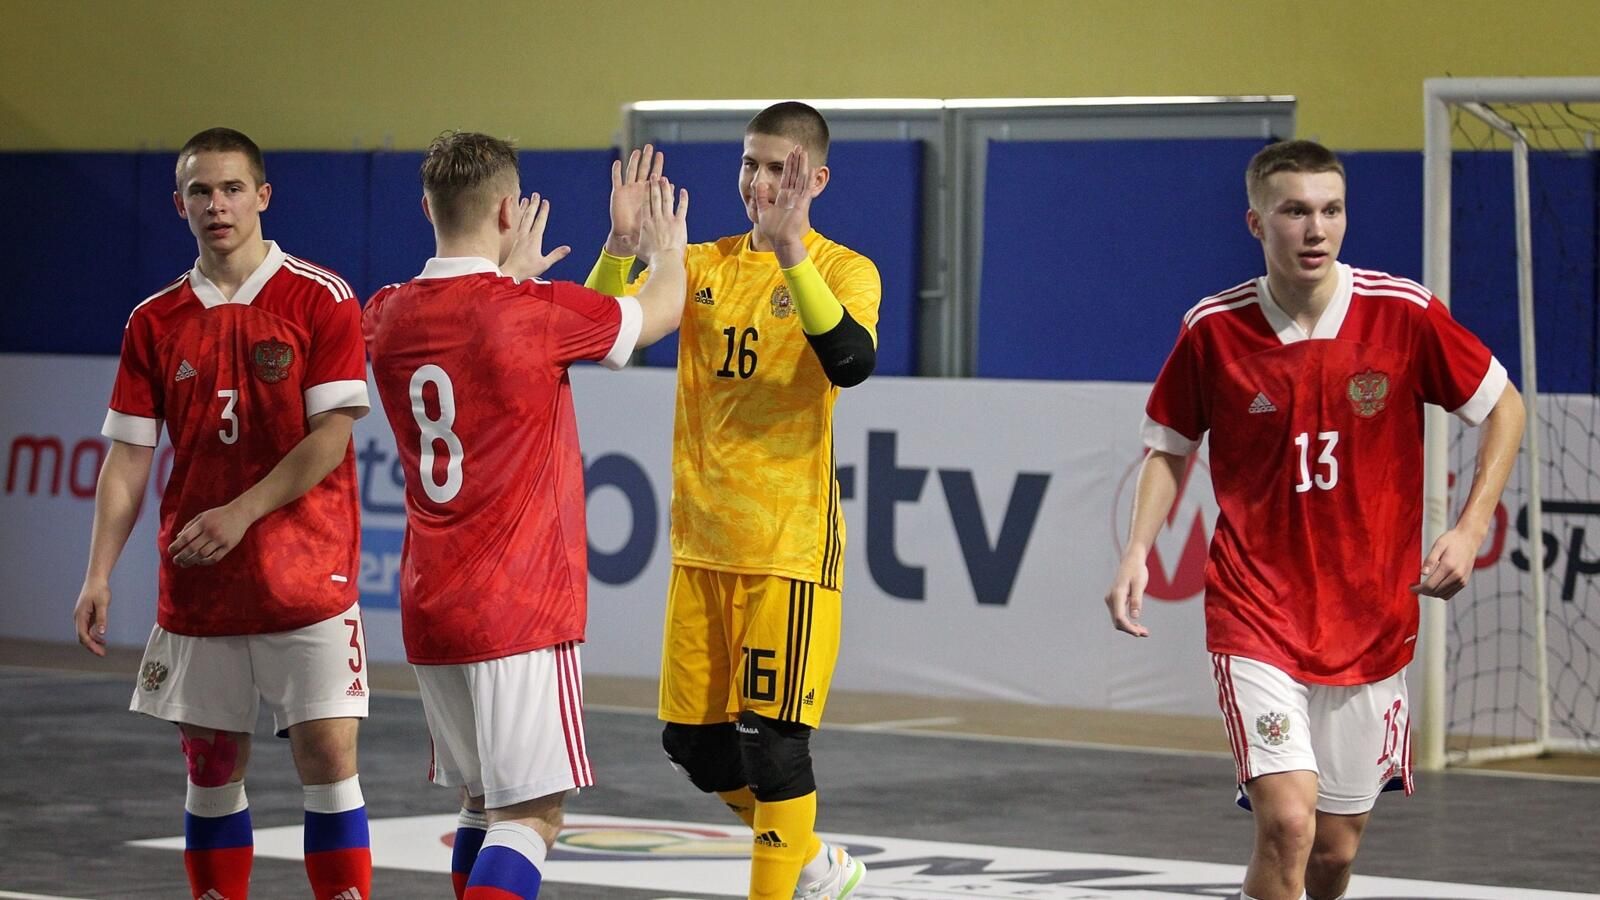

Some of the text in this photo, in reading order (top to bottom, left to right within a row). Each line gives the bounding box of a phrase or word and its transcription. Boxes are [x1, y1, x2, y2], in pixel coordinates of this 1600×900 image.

[716, 326, 759, 379] 16
[217, 389, 239, 445] 3
[408, 363, 465, 504] 8
[1294, 431, 1339, 493] 13
[343, 618, 362, 673] 3
[741, 646, 777, 702] 16
[1376, 698, 1402, 766] 13
